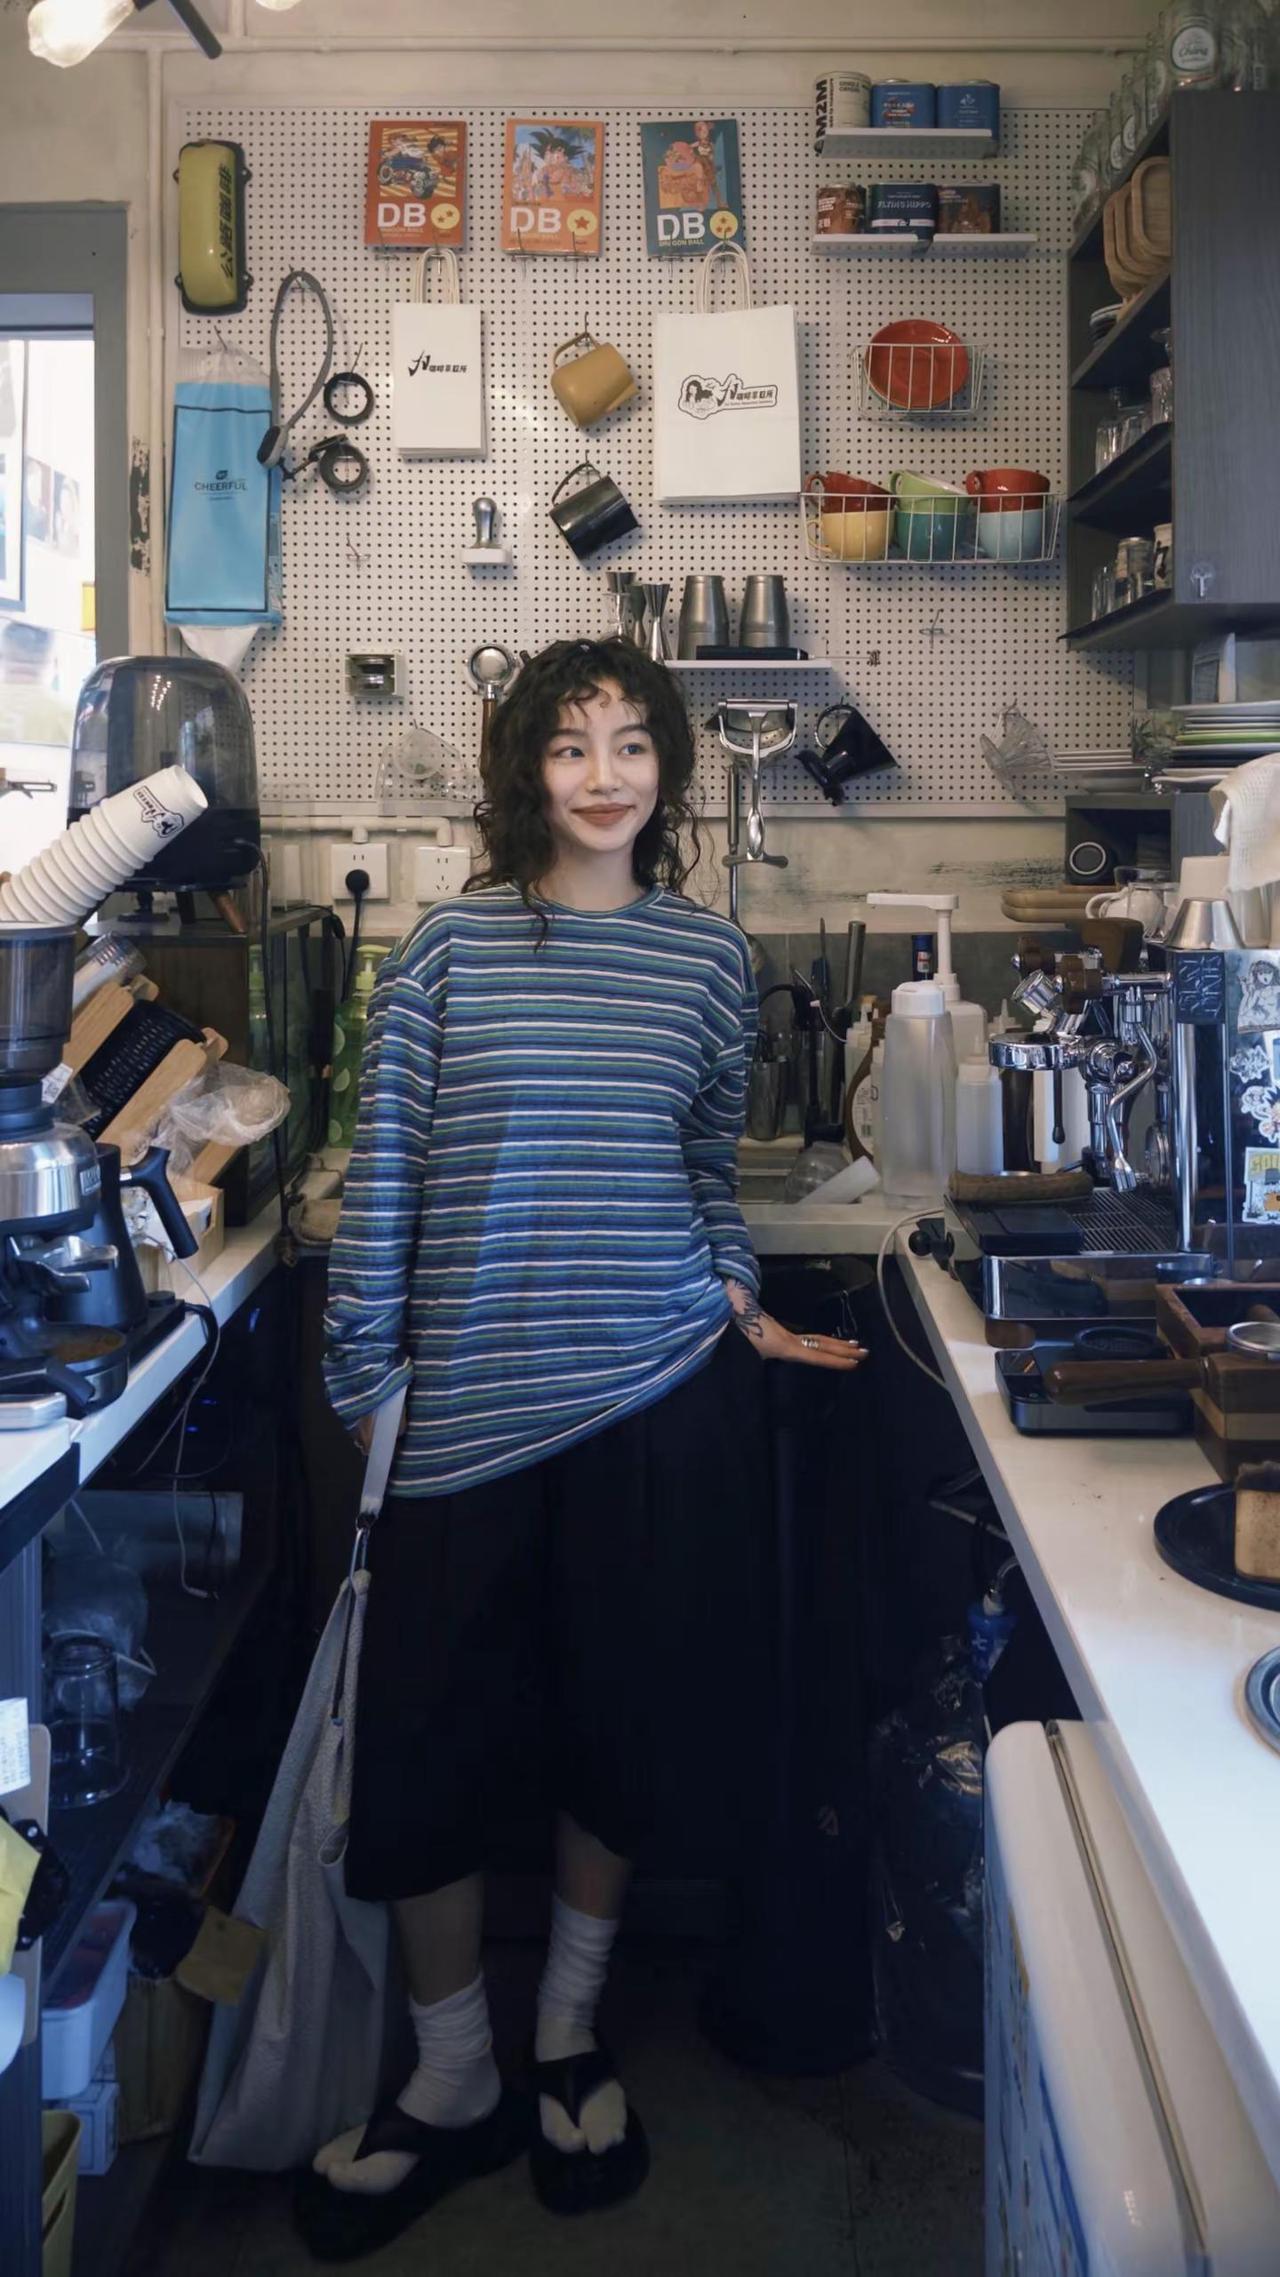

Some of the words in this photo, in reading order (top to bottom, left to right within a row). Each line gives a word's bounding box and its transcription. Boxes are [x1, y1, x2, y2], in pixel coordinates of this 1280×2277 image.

[377, 202, 426, 228] DB
[510, 206, 562, 233] DB
[656, 212, 706, 241] DB
[194, 480, 247, 492] CHEERFUL
